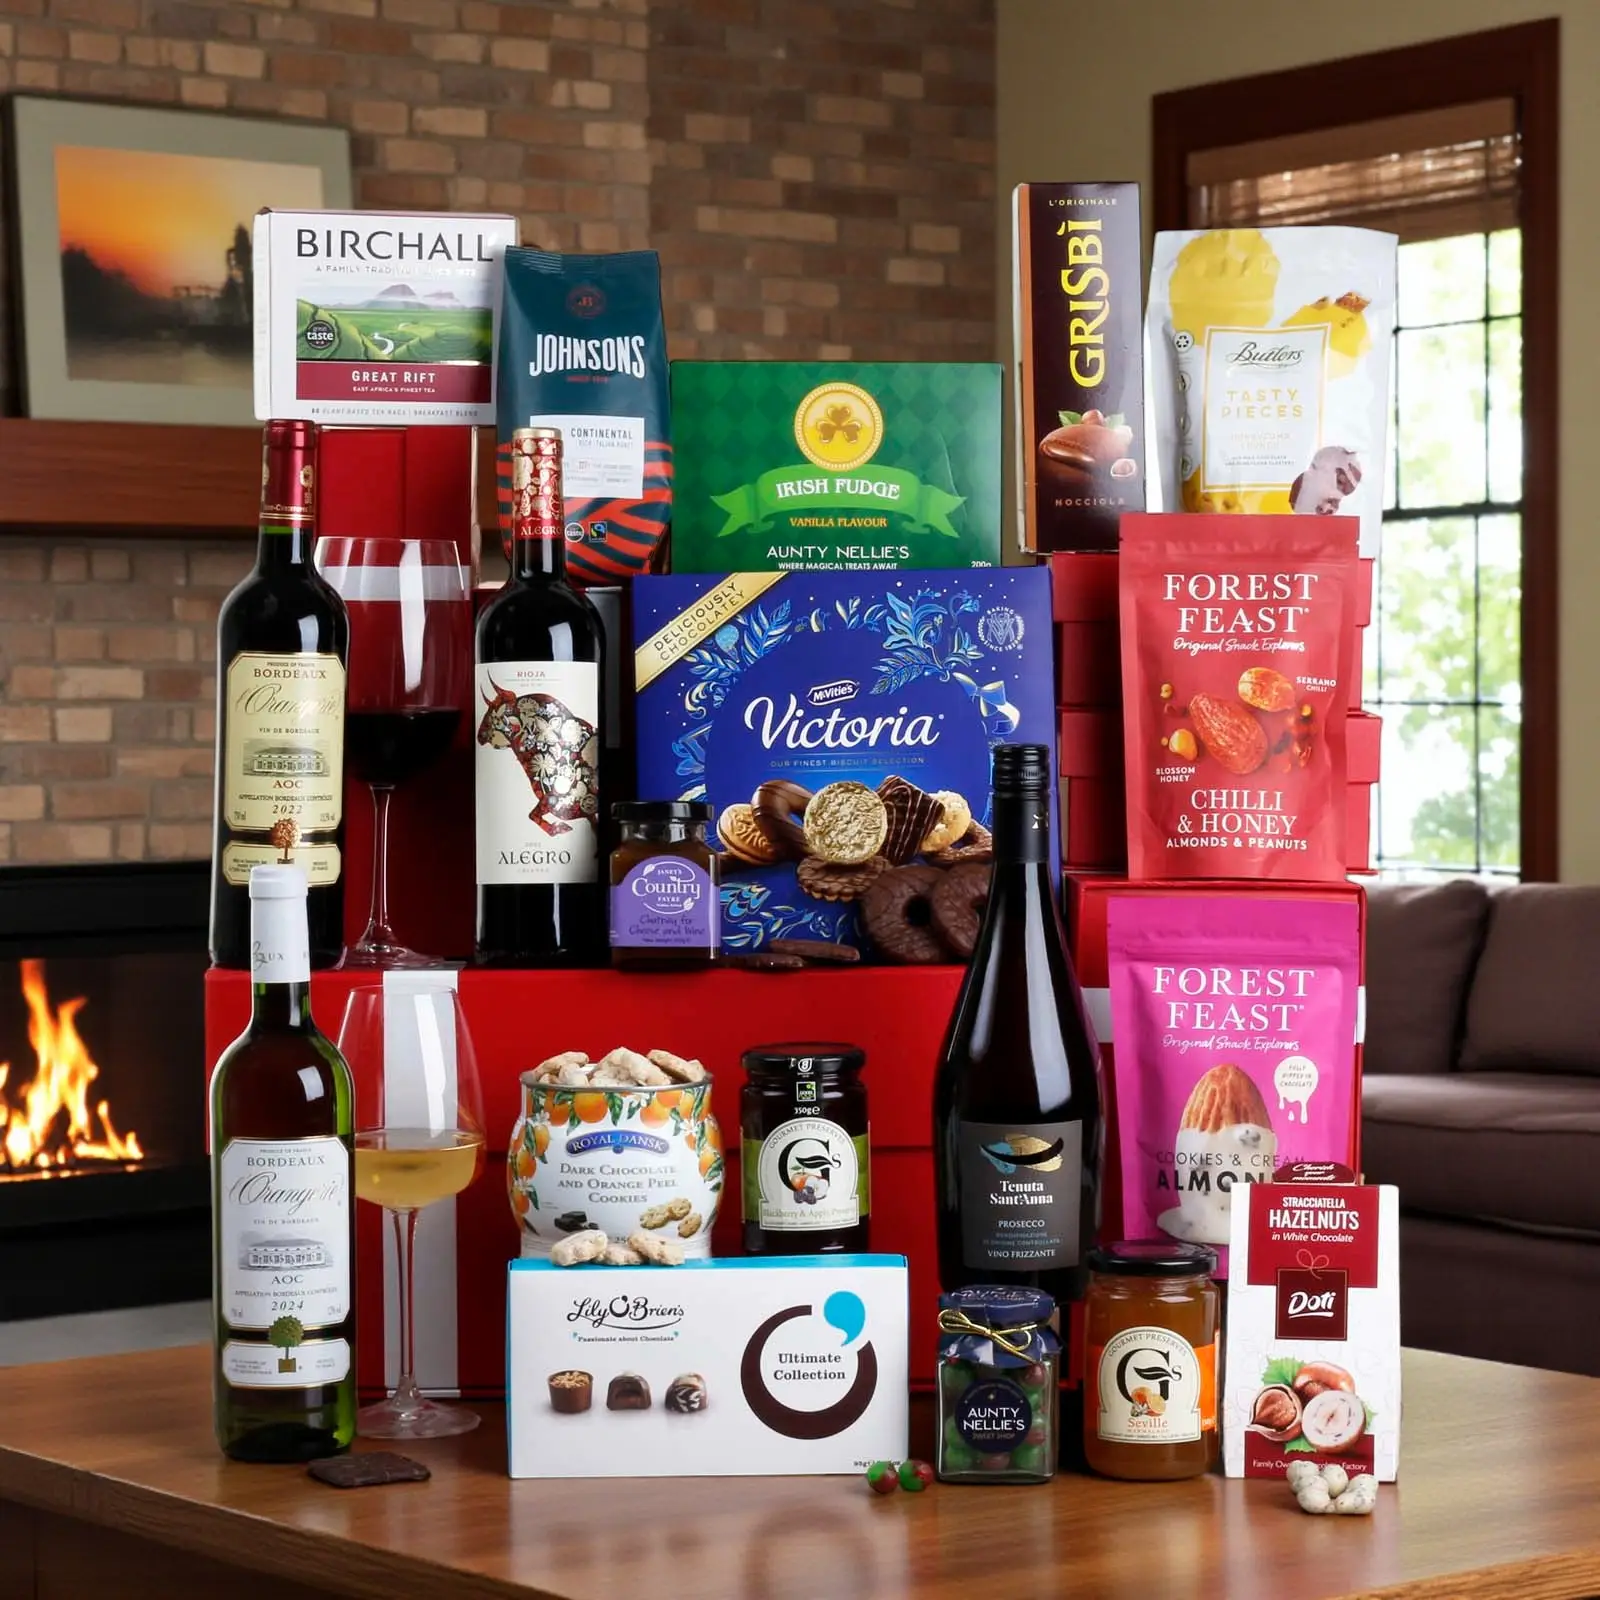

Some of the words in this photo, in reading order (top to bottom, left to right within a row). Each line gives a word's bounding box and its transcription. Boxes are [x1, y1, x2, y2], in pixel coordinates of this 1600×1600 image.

[1048, 198, 1117, 206] L'ORIGINALE
[296, 228, 493, 262] BIRCHALL
[326, 264, 360, 274] FAMILY
[1057, 219, 1110, 388] GRISBÌ
[307, 332, 334, 340] taste
[529, 334, 645, 378] JOHNSONS
[1226, 342, 1304, 368] Butlers
[352, 370, 397, 382] GREAT
[404, 371, 436, 384] RIFT
[1227, 388, 1299, 402] TASTY
[1222, 404, 1304, 418] PIECES
[571, 428, 632, 440] CONTINENTAL
[776, 479, 828, 499] IRISH
[835, 479, 900, 500] FUDGE
[790, 518, 834, 528] VANILLA
[838, 518, 888, 528] FLAVOUR
[766, 546, 829, 559] AUNTY
[836, 546, 910, 560] NELLIE'S
[778, 562, 804, 570] WHERE
[806, 562, 843, 570] MAGICAL
[844, 562, 872, 570] TREATS
[872, 562, 898, 570] AWAIT
[1163, 574, 1318, 601] FOREST
[654, 582, 737, 652] DELICIOUSLY
[1177, 607, 1304, 634] FEAST
[660, 590, 746, 662] CHOCOLATEY
[1174, 638, 1222, 656] Original
[1225, 639, 1259, 653] Snack
[1262, 640, 1305, 654] Explorers
[254, 668, 326, 679] BORDEAUX
[1296, 676, 1336, 687] SERRANO
[1306, 684, 1328, 692] CHILLI
[744, 696, 940, 750] Victoria
[1156, 766, 1196, 775] BLOSSOM
[273, 780, 304, 789] AOC
[1160, 775, 1190, 783] HONEY
[1191, 790, 1282, 811] CHILLI
[272, 804, 304, 814] 2022
[1177, 816, 1193, 833] &
[1200, 814, 1296, 836] HONEY
[1166, 837, 1228, 848] ALMONDS
[1234, 838, 1242, 848] &
[1248, 838, 1307, 850] PEANUTS
[498, 851, 571, 865] ALEGRO
[632, 877, 700, 900] Country
[639, 915, 677, 926] Chutney
[680, 915, 692, 925] for
[628, 924, 660, 936] Cheese
[662, 926, 681, 934] and
[684, 926, 706, 934] Wine
[1152, 966, 1314, 998] FOREST
[1168, 1002, 1299, 1032] FEAST
[1162, 1035, 1214, 1054] Original
[1216, 1036, 1252, 1050] Snack
[1254, 1037, 1300, 1052] Explorers
[769, 1124, 805, 1149] GOURMET
[806, 1123, 845, 1145] PRESERVES
[572, 1136, 616, 1152] ROYAL
[618, 1136, 665, 1152] DANSK
[247, 1156, 325, 1167] BORDEAUX
[1155, 1152, 1224, 1166] COOKIES
[1233, 1154, 1242, 1166] &
[1000, 1180, 1044, 1192] Tenuta
[1156, 1170, 1273, 1194] ALMON
[1282, 1196, 1346, 1208] STRACCIATELLA
[998, 1220, 1046, 1228] PROSECCO
[1269, 1209, 1360, 1230] HAZELNUTS
[1272, 1232, 1280, 1242] in
[1282, 1232, 1308, 1242] White
[1310, 1232, 1354, 1243] Chocolate
[988, 1250, 1010, 1258] VINO
[1011, 1250, 1056, 1258] FRIZZANTE
[272, 1274, 304, 1284] AOC
[272, 1300, 304, 1311] 2024
[1108, 1333, 1142, 1357] GOURMET
[1146, 1333, 1186, 1357] PRESERVES
[778, 1352, 841, 1364] Ultimate
[772, 1369, 846, 1382] Collection
[968, 1408, 1020, 1418] AUNTY
[963, 1419, 1025, 1431] NELLIE'S
[1128, 1418, 1168, 1428] Seville
[972, 1432, 995, 1440] SWEET
[1252, 1459, 1273, 1469] Family
[1342, 1460, 1366, 1472] Factory
